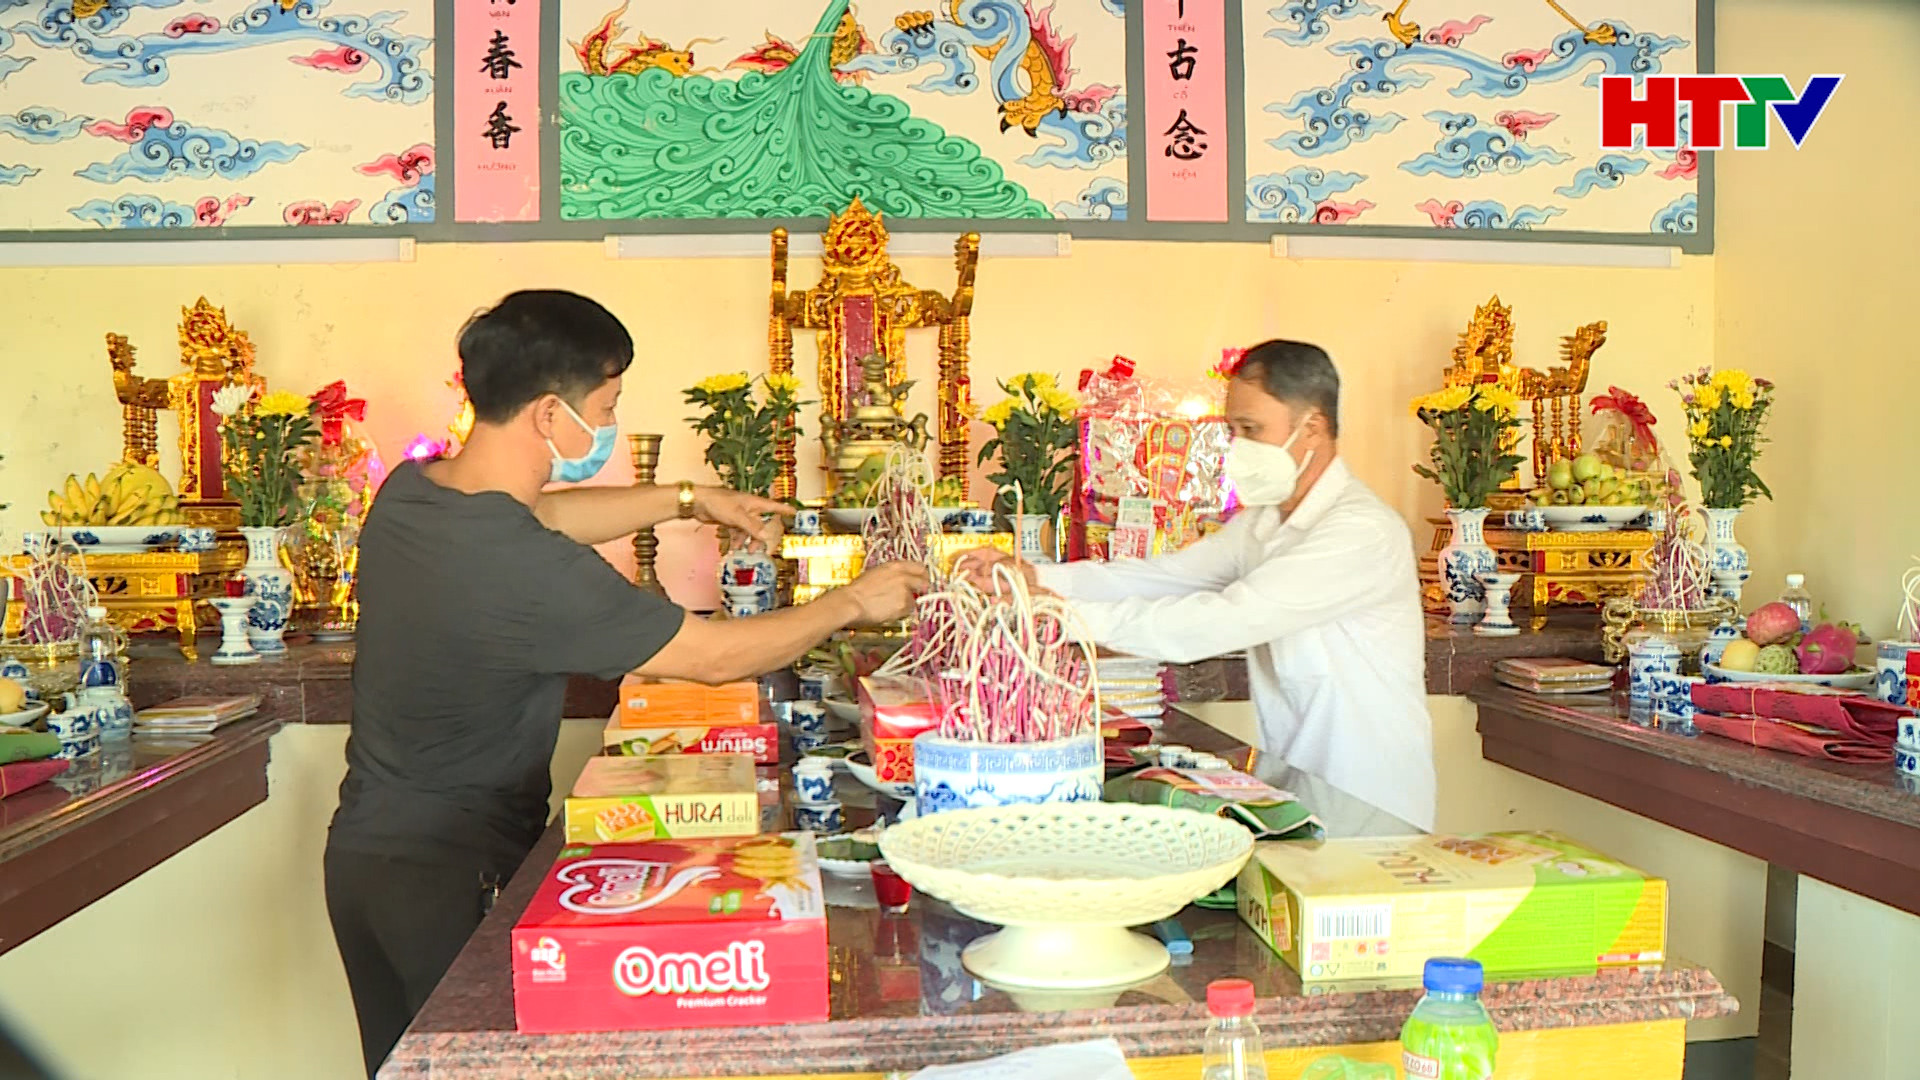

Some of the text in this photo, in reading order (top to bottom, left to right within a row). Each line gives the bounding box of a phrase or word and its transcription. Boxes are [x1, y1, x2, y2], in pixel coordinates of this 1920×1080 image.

[665, 802, 723, 824] HURA
[612, 940, 770, 996] Omeli
[676, 995, 767, 1008] Premium Cracker
